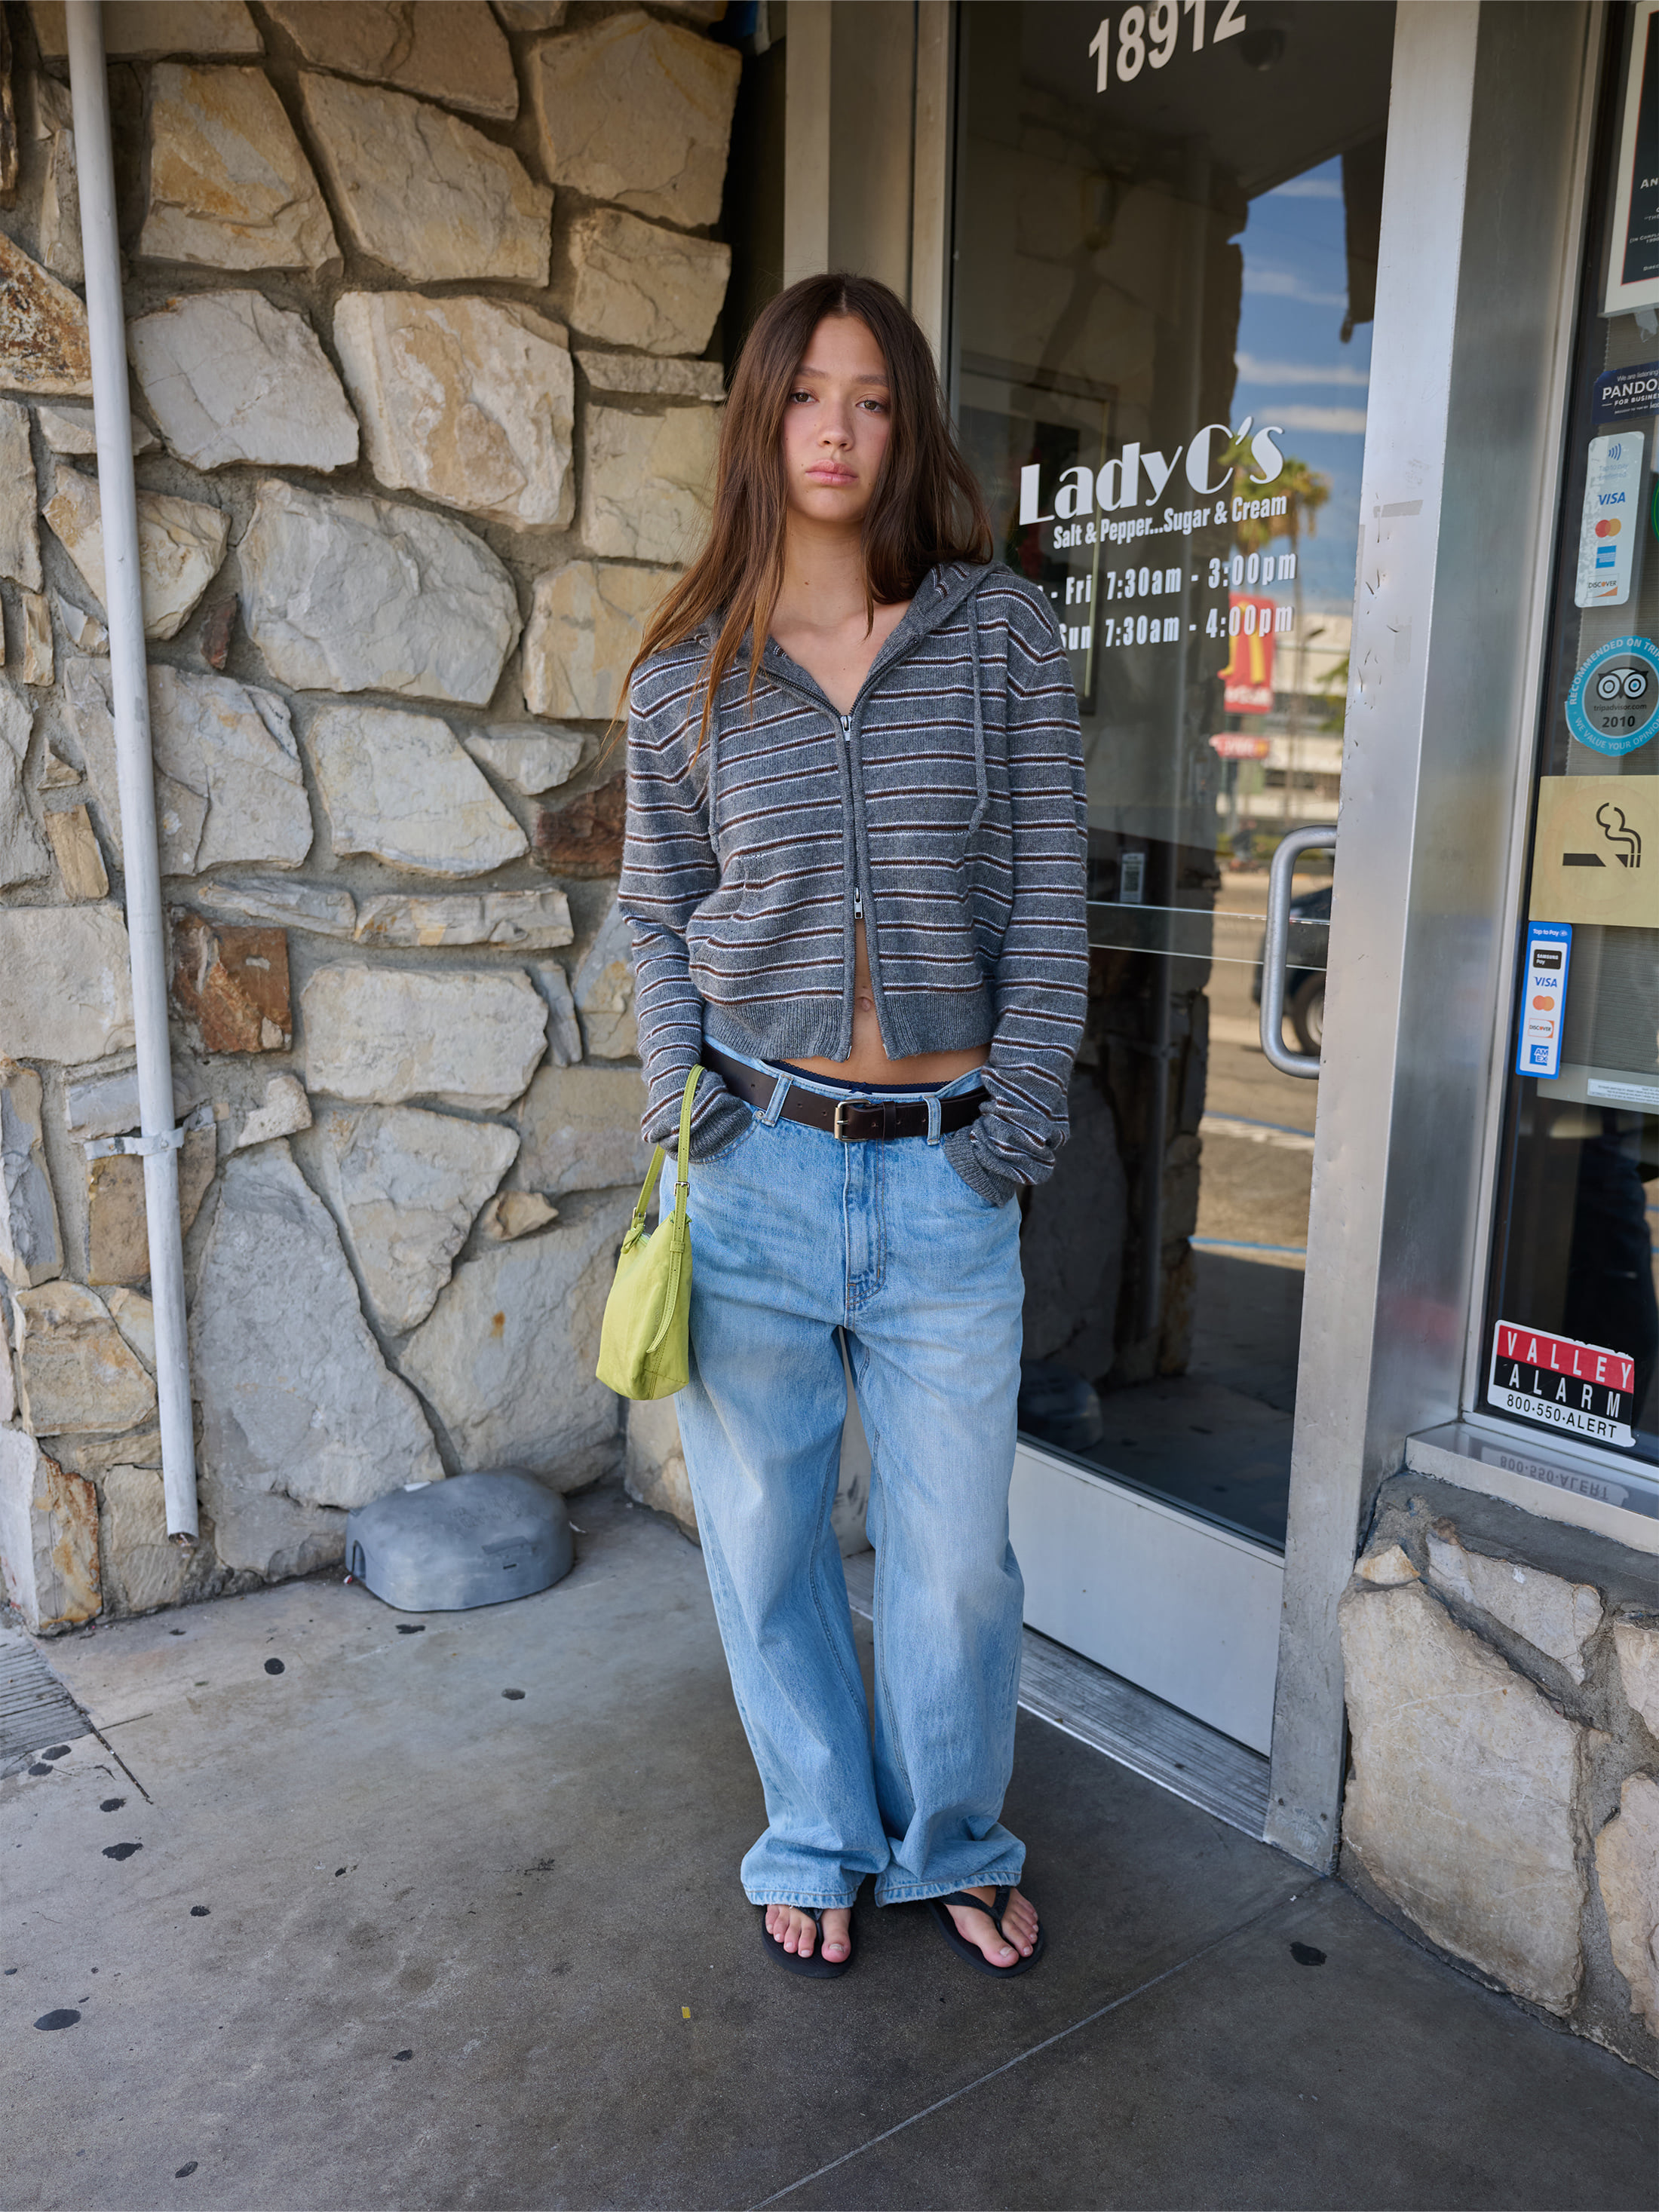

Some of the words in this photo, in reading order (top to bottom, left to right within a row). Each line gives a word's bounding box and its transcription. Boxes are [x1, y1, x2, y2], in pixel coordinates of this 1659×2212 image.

[1602, 378, 1659, 400] PANDO
[1614, 398, 1629, 406] FOR
[1598, 492, 1626, 505] VISA
[1053, 523, 1083, 550] Salt
[1084, 522, 1097, 544] &
[1213, 500, 1228, 525] &
[1231, 495, 1287, 522] Cream
[1066, 574, 1092, 605] Fri
[1107, 567, 1182, 601] 7:30am
[1208, 552, 1297, 589] 3:00pm
[1588, 580, 1617, 589] DISCOVER
[1105, 615, 1180, 648] 7:30am
[1205, 604, 1293, 639] 4:00pm
[1569, 639, 1624, 705] RECOMMENDED
[1626, 638, 1642, 648] ON
[1643, 642, 1659, 660] TRIP
[1593, 704, 1647, 712] tripadvisor.com
[1602, 715, 1636, 728] 2010
[1575, 717, 1586, 731] WE
[1584, 731, 1607, 749] VALUE
[1608, 741, 1632, 750] YOUR
[1533, 976, 1557, 988] VISA
[1507, 1331, 1632, 1389] VALLEY
[1508, 1363, 1621, 1418] ALARM
